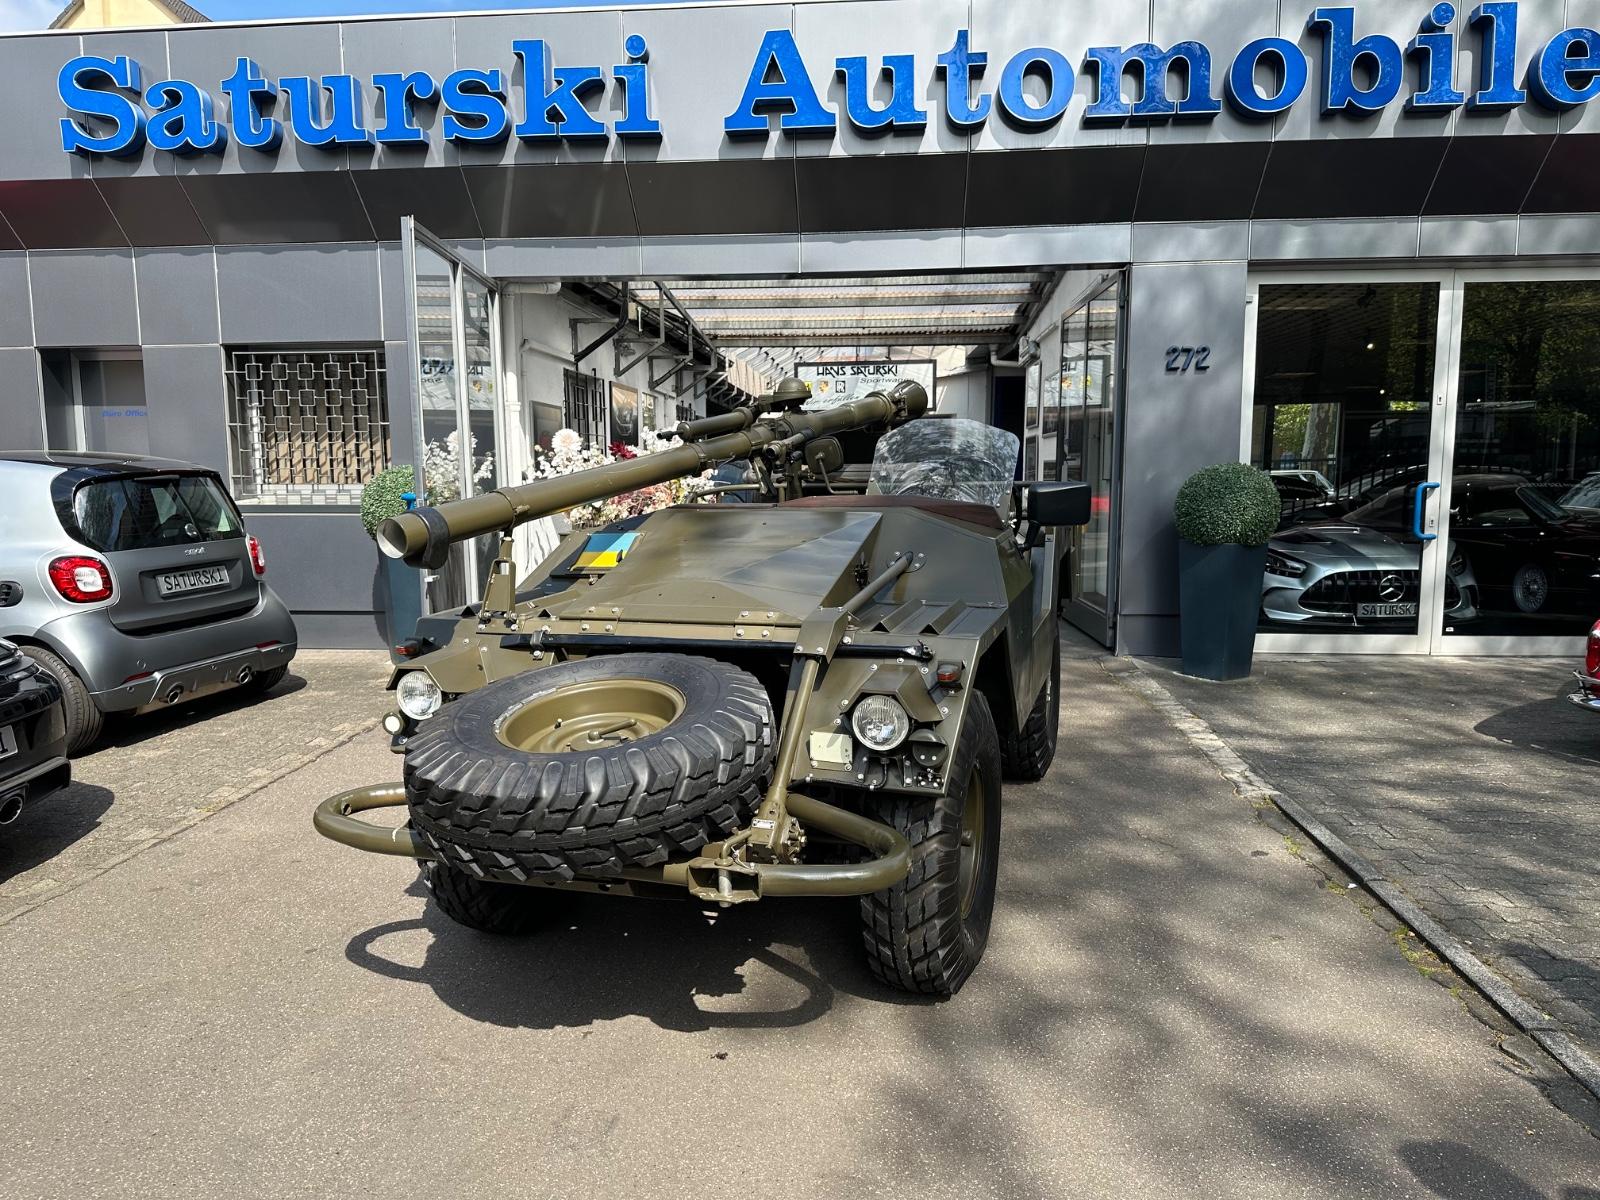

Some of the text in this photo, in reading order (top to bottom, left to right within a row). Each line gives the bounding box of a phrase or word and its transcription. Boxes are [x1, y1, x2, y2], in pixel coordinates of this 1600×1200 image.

[57, 1, 1600, 156] Saturski Automobile
[816, 365, 898, 378] HANS SATURSKI
[1165, 345, 1211, 372] 272
